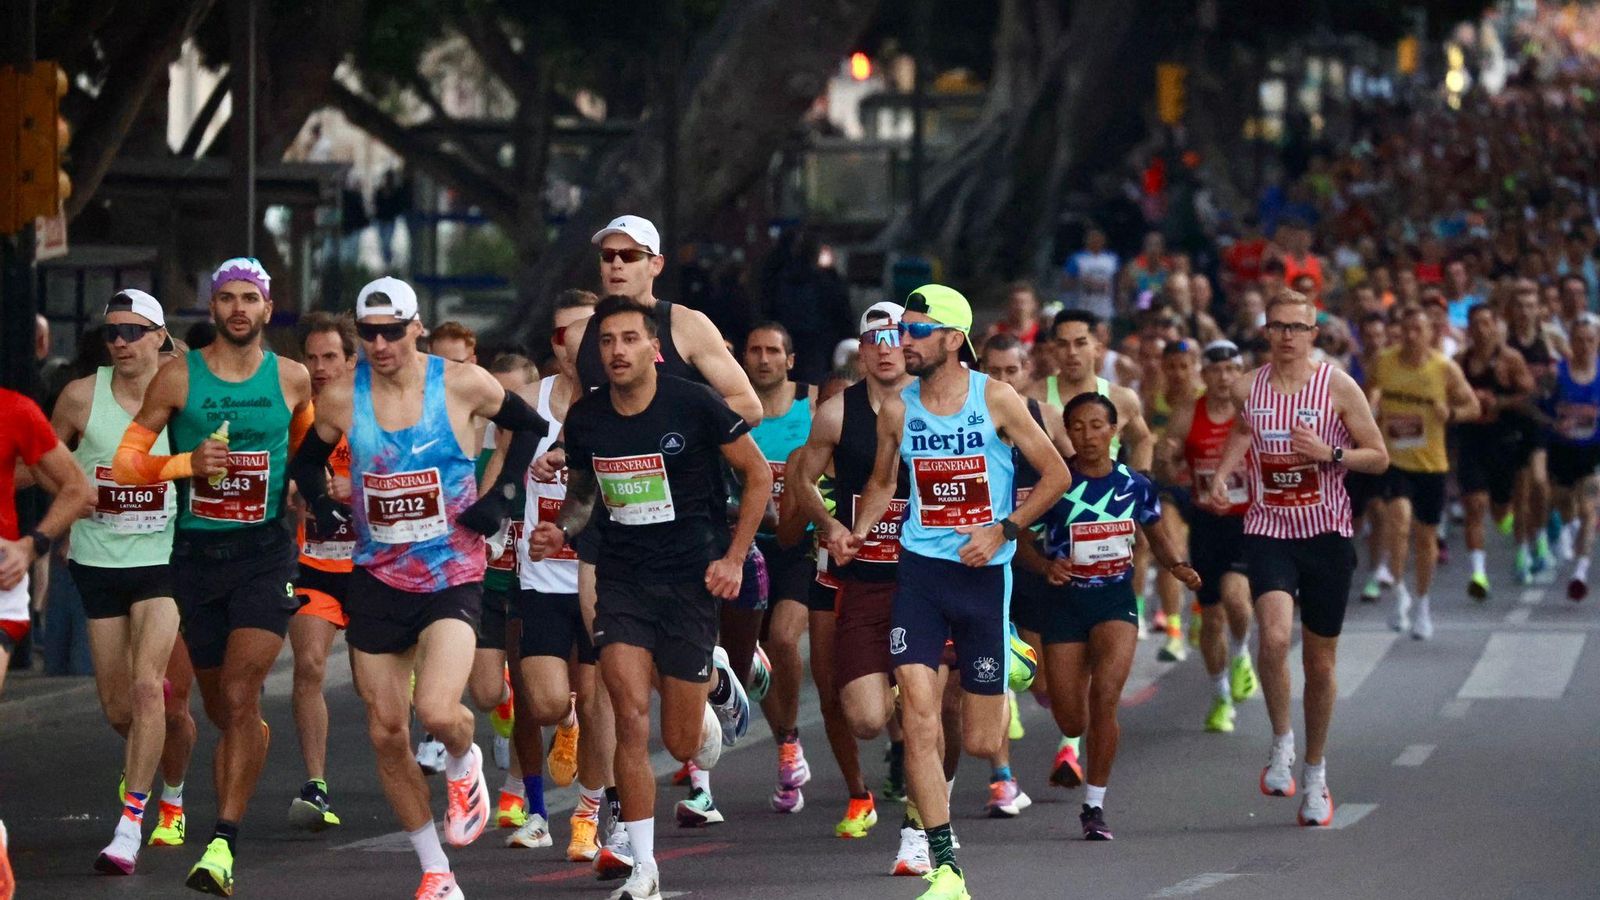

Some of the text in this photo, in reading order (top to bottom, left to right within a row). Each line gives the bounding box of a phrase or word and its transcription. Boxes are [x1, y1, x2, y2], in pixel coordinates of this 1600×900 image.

[967, 411, 984, 426] ds
[911, 427, 984, 455] nerja
[228, 455, 266, 467] NERALI
[608, 458, 658, 471] GENERALI
[931, 462, 980, 471] GENERALI
[379, 473, 432, 489] GENERALI
[1272, 472, 1302, 483] 5373
[609, 481, 651, 495] 18057
[932, 482, 967, 496] 6251
[110, 490, 153, 503] 14160
[379, 497, 426, 513] 17212
[871, 522, 900, 534] 598
[1088, 522, 1131, 534] GENERALI
